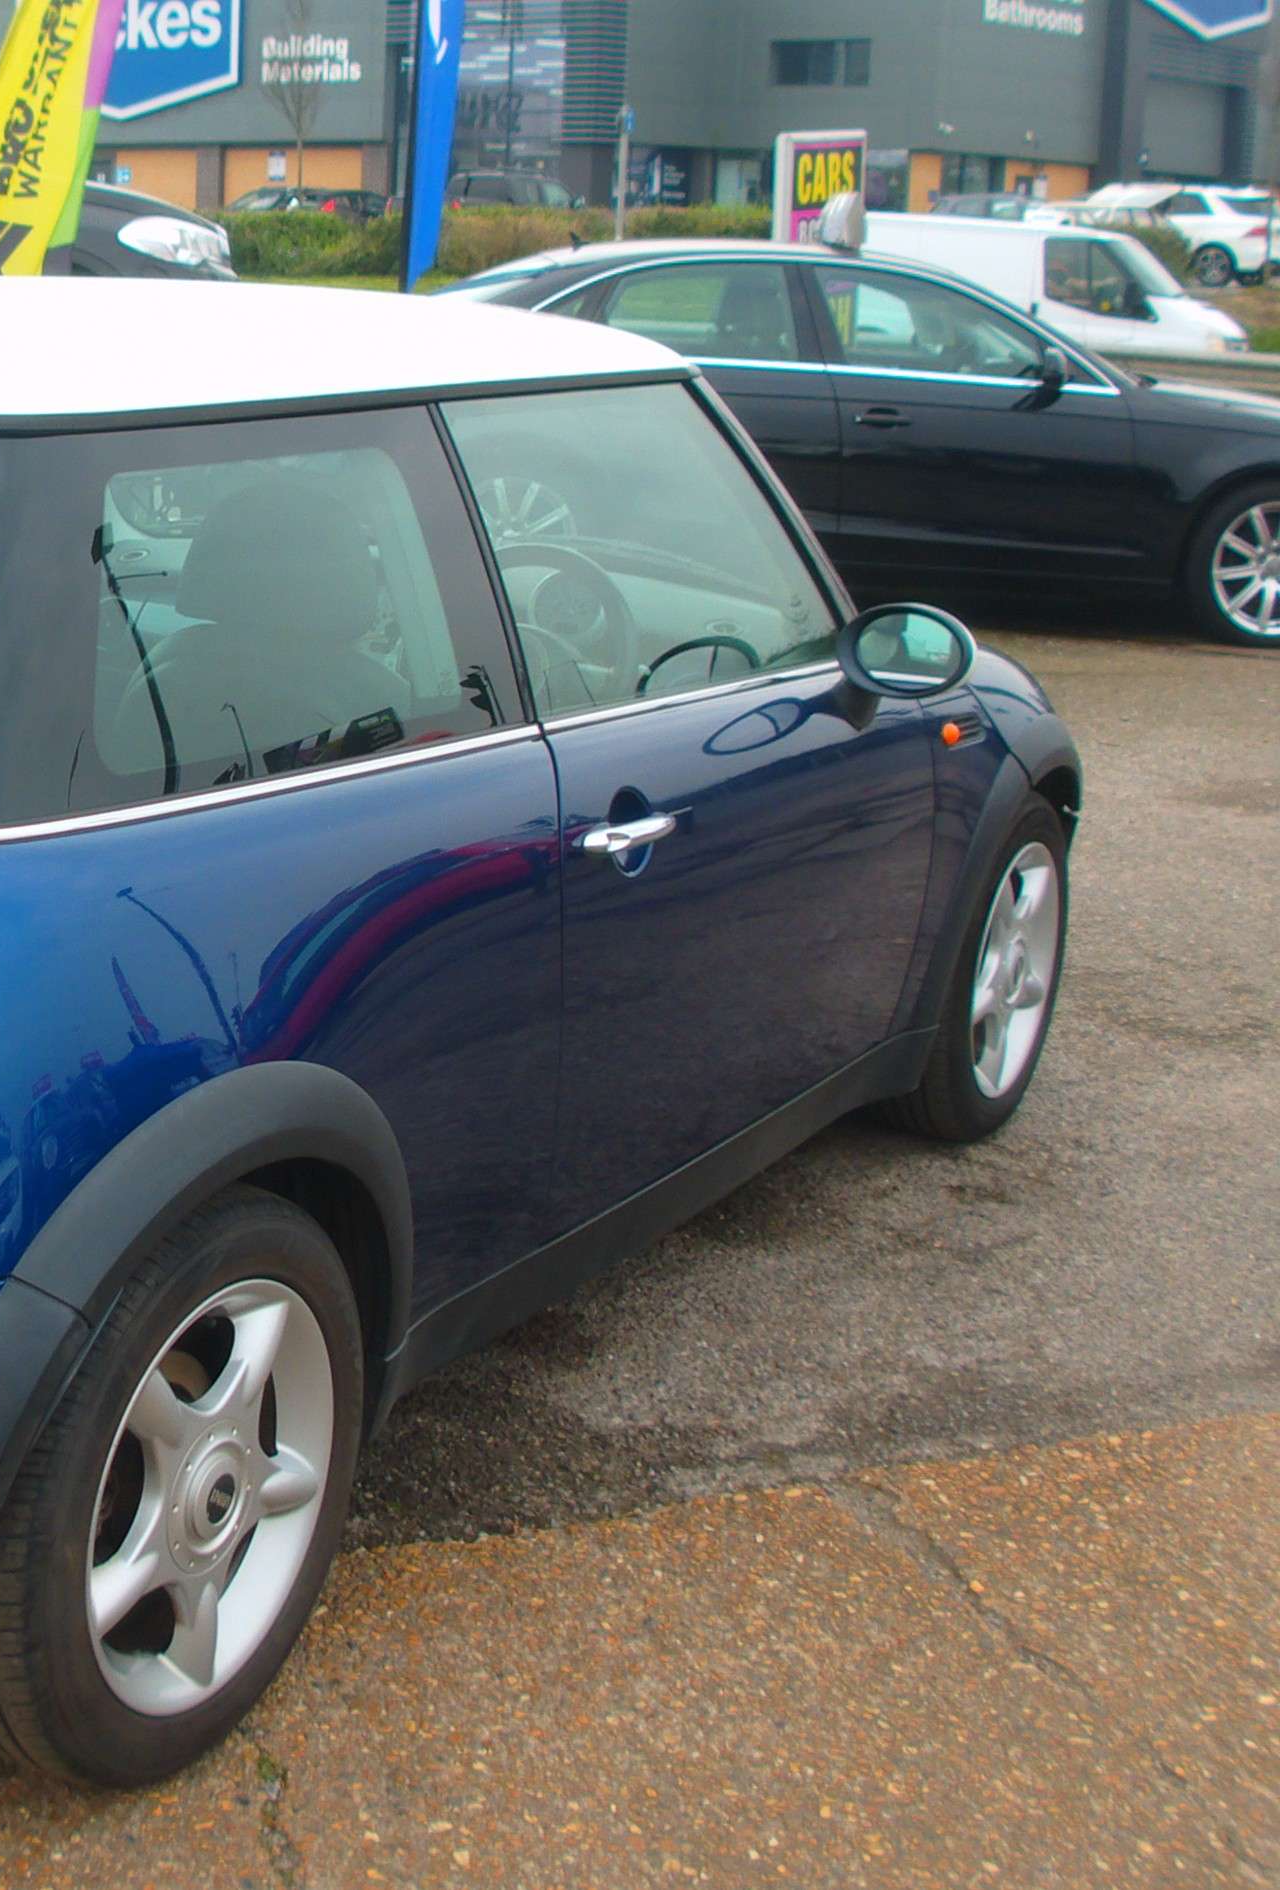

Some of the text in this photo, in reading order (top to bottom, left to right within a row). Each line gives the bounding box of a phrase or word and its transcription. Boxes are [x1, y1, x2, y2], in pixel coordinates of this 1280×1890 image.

[262, 34, 349, 60] Building
[261, 58, 362, 83] Materials
[798, 150, 855, 205] CARS
